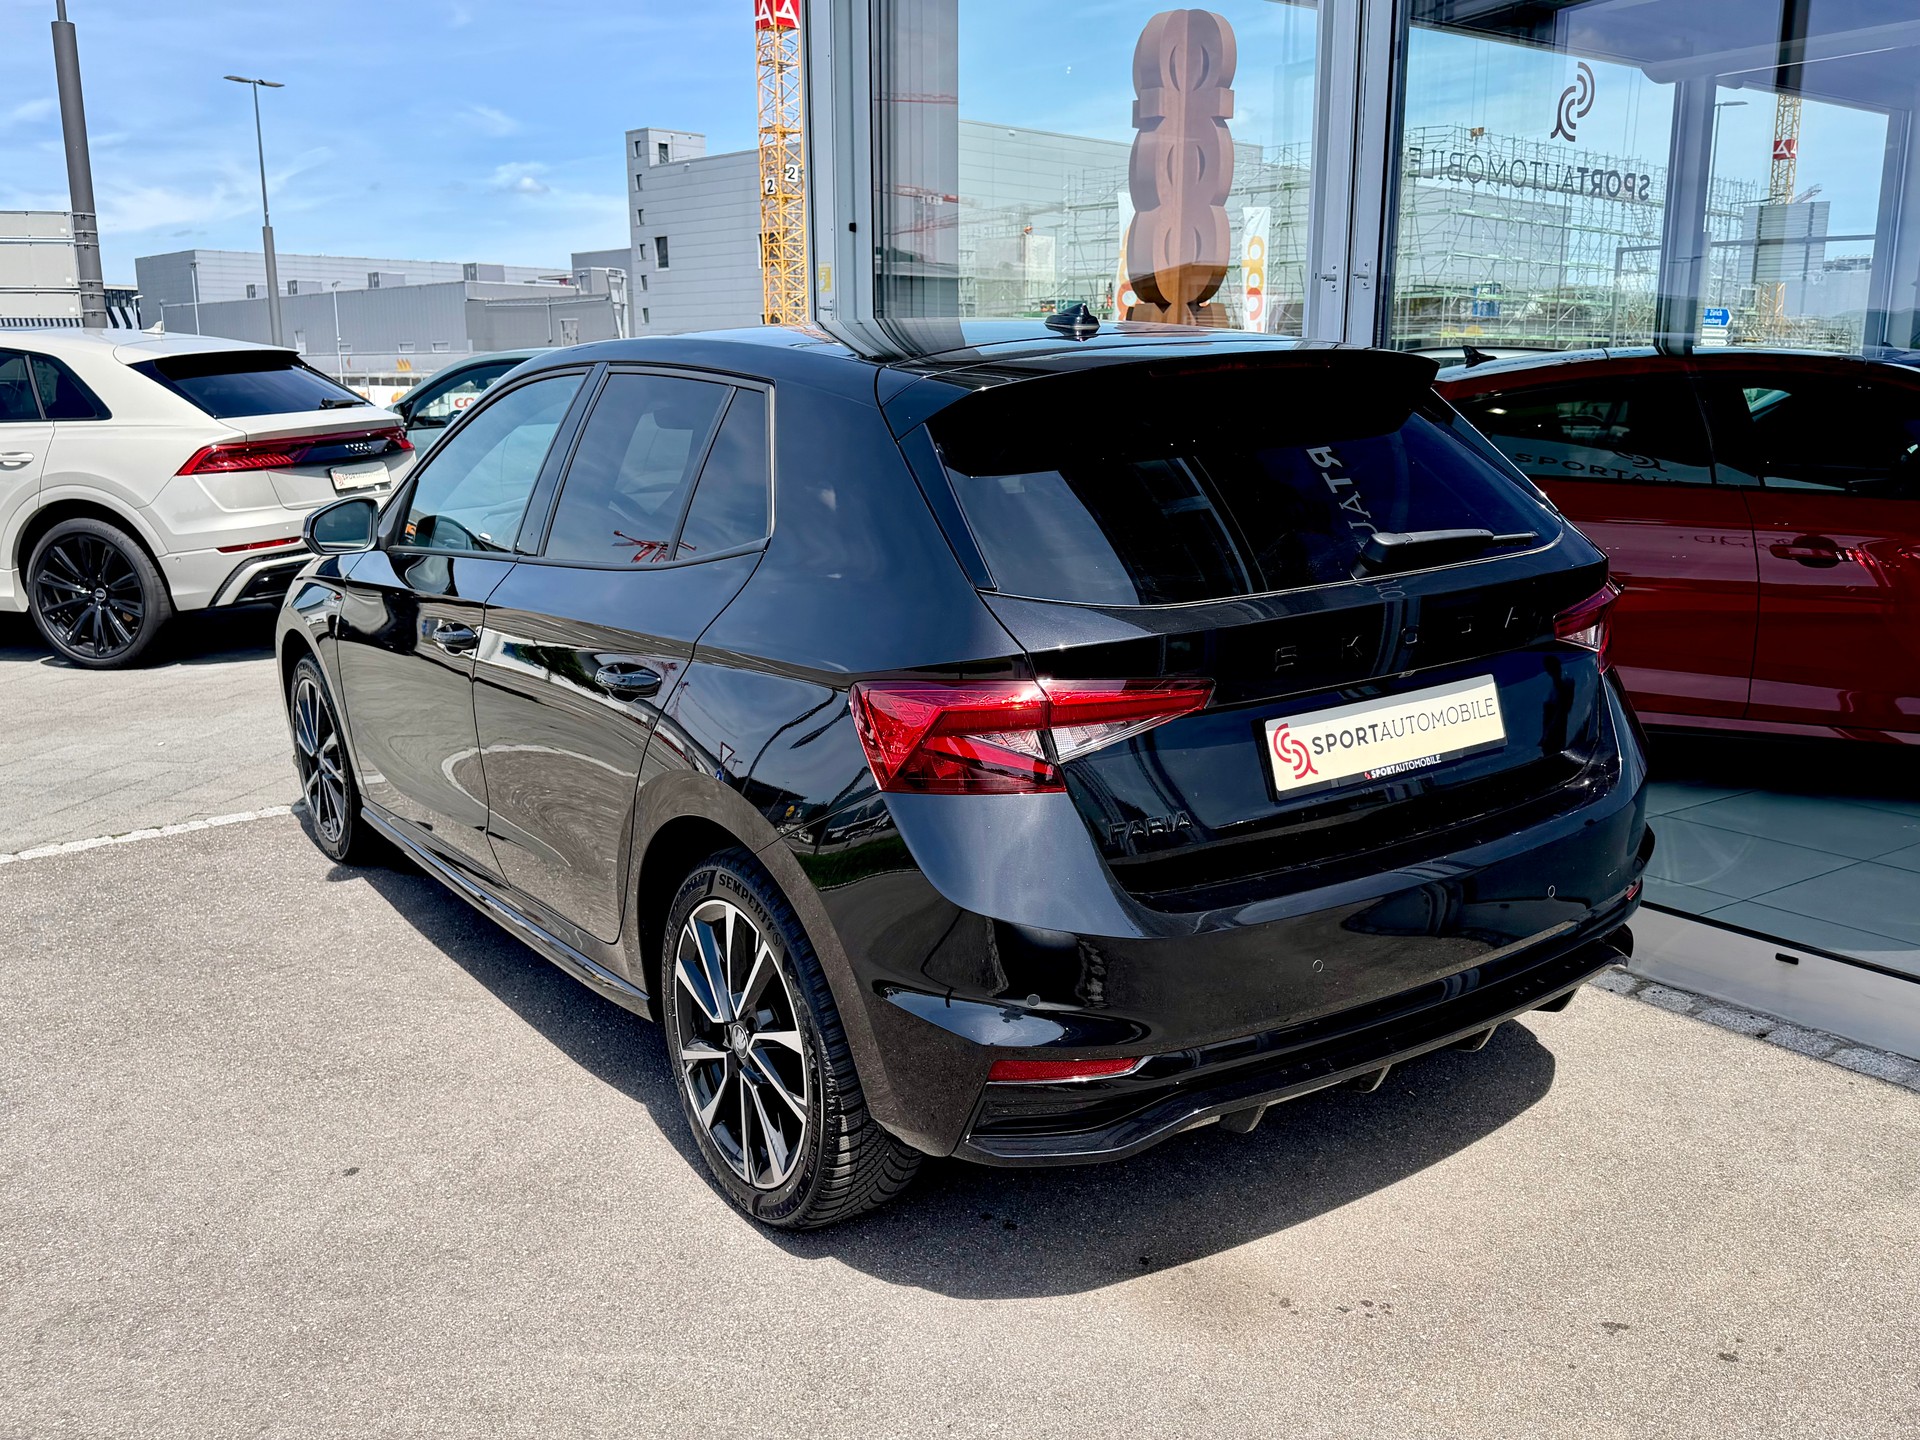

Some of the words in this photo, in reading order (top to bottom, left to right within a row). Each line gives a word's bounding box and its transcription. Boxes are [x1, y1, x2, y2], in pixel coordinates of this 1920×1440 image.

[787, 166, 796, 180] 2
[767, 179, 774, 193] 2
[1311, 697, 1496, 755] SPORTAUTOMOBILE
[1371, 755, 1441, 778] SPORTAUTOMOBILE
[1109, 810, 1194, 845] FABIA
